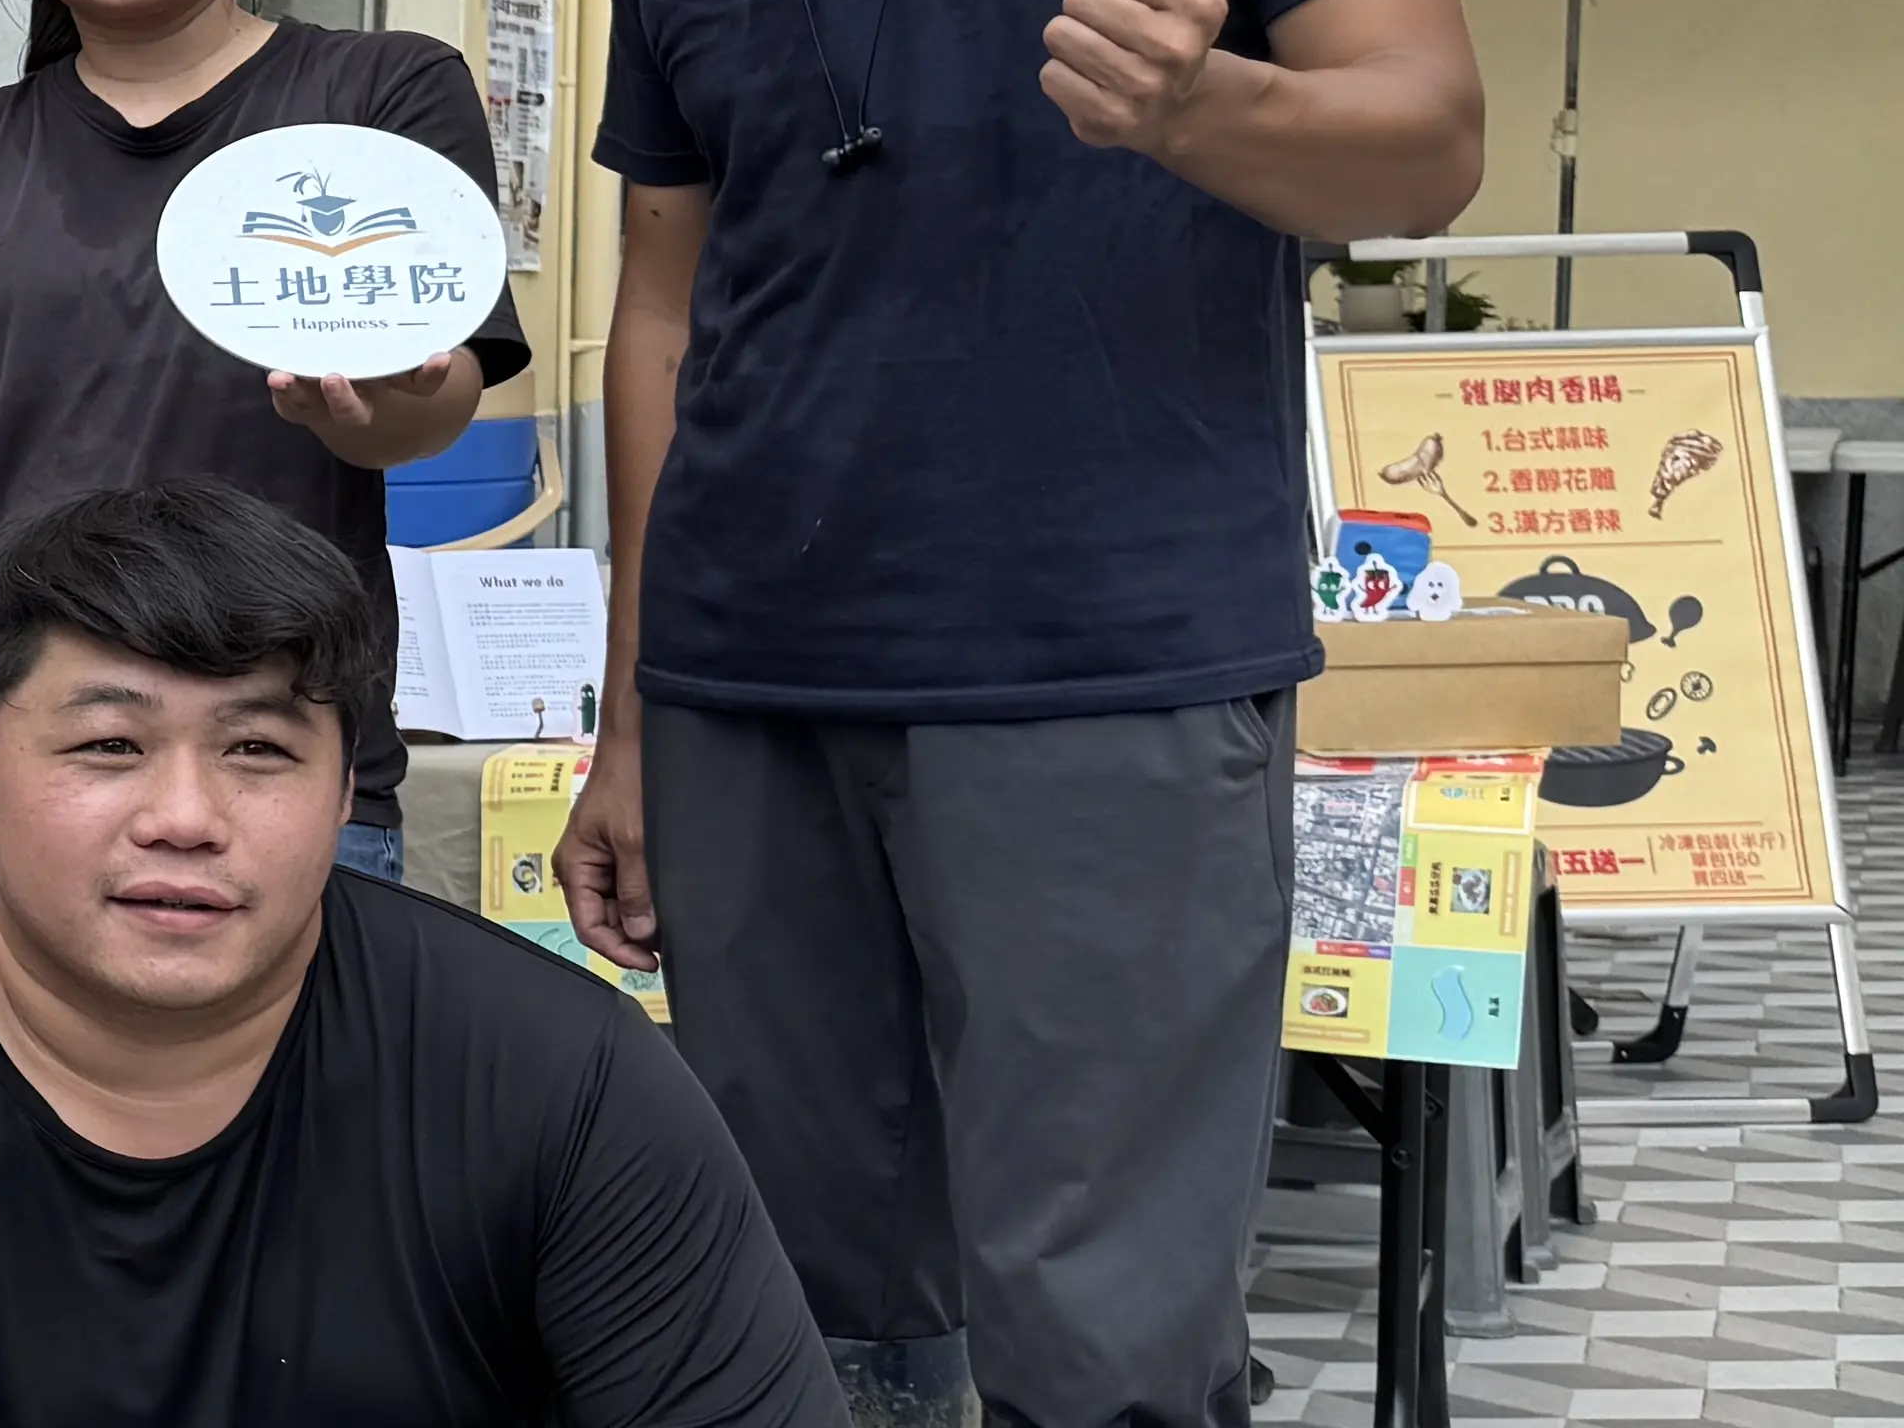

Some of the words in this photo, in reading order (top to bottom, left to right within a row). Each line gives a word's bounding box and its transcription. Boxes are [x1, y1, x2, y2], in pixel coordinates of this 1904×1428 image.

[209, 261, 466, 306] 土地學院
[292, 316, 389, 333] Happiness
[1459, 374, 1622, 406] 雞腿肉香腸
[479, 575, 518, 588] What
[522, 578, 542, 588] we
[546, 574, 564, 588] do
[1550, 849, 1645, 876] 五送一
